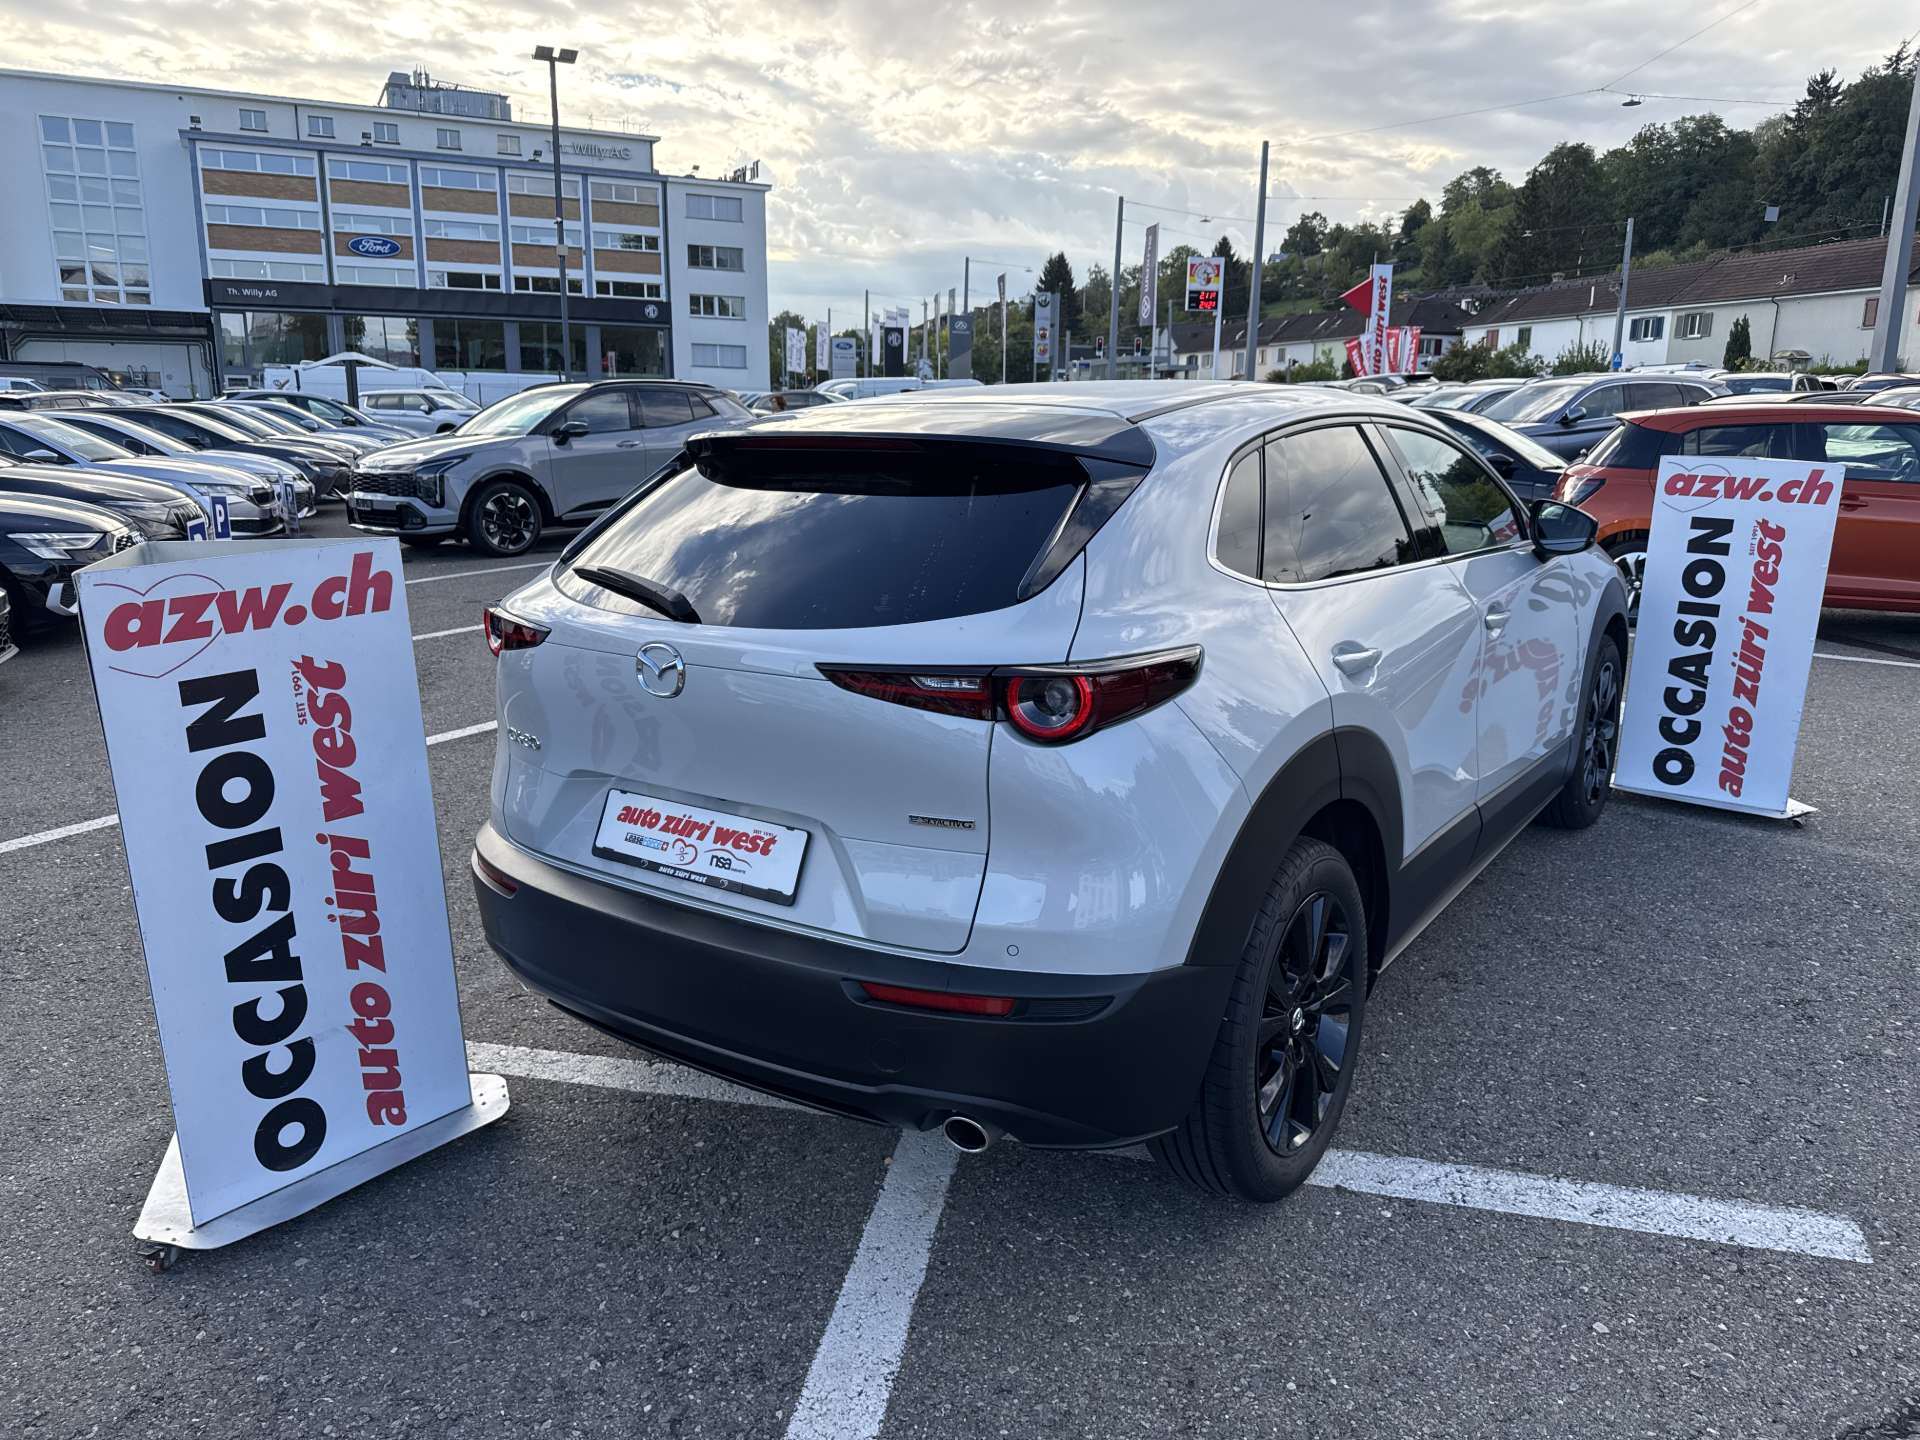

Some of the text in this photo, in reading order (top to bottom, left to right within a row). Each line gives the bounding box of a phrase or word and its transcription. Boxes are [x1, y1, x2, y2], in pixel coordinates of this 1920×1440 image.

[573, 142, 606, 161] Willy
[608, 145, 633, 160] AG
[358, 238, 391, 254] Ford
[227, 287, 278, 298] Th. Willy AG
[1664, 469, 1834, 506] azw.ch
[215, 503, 225, 533] P
[1748, 543, 1756, 556] SEIT
[104, 552, 393, 652] azw.ch
[1652, 516, 1735, 786] OCCASION
[1719, 518, 1787, 798] auto züri west
[291, 669, 308, 725] SEIT 1991
[616, 804, 778, 856] auto züri west
[658, 865, 674, 875] auto
[690, 872, 708, 884] west
[710, 854, 731, 870] nsa
[290, 654, 407, 1126] auto züri west
[178, 668, 327, 1172] OCCASION
